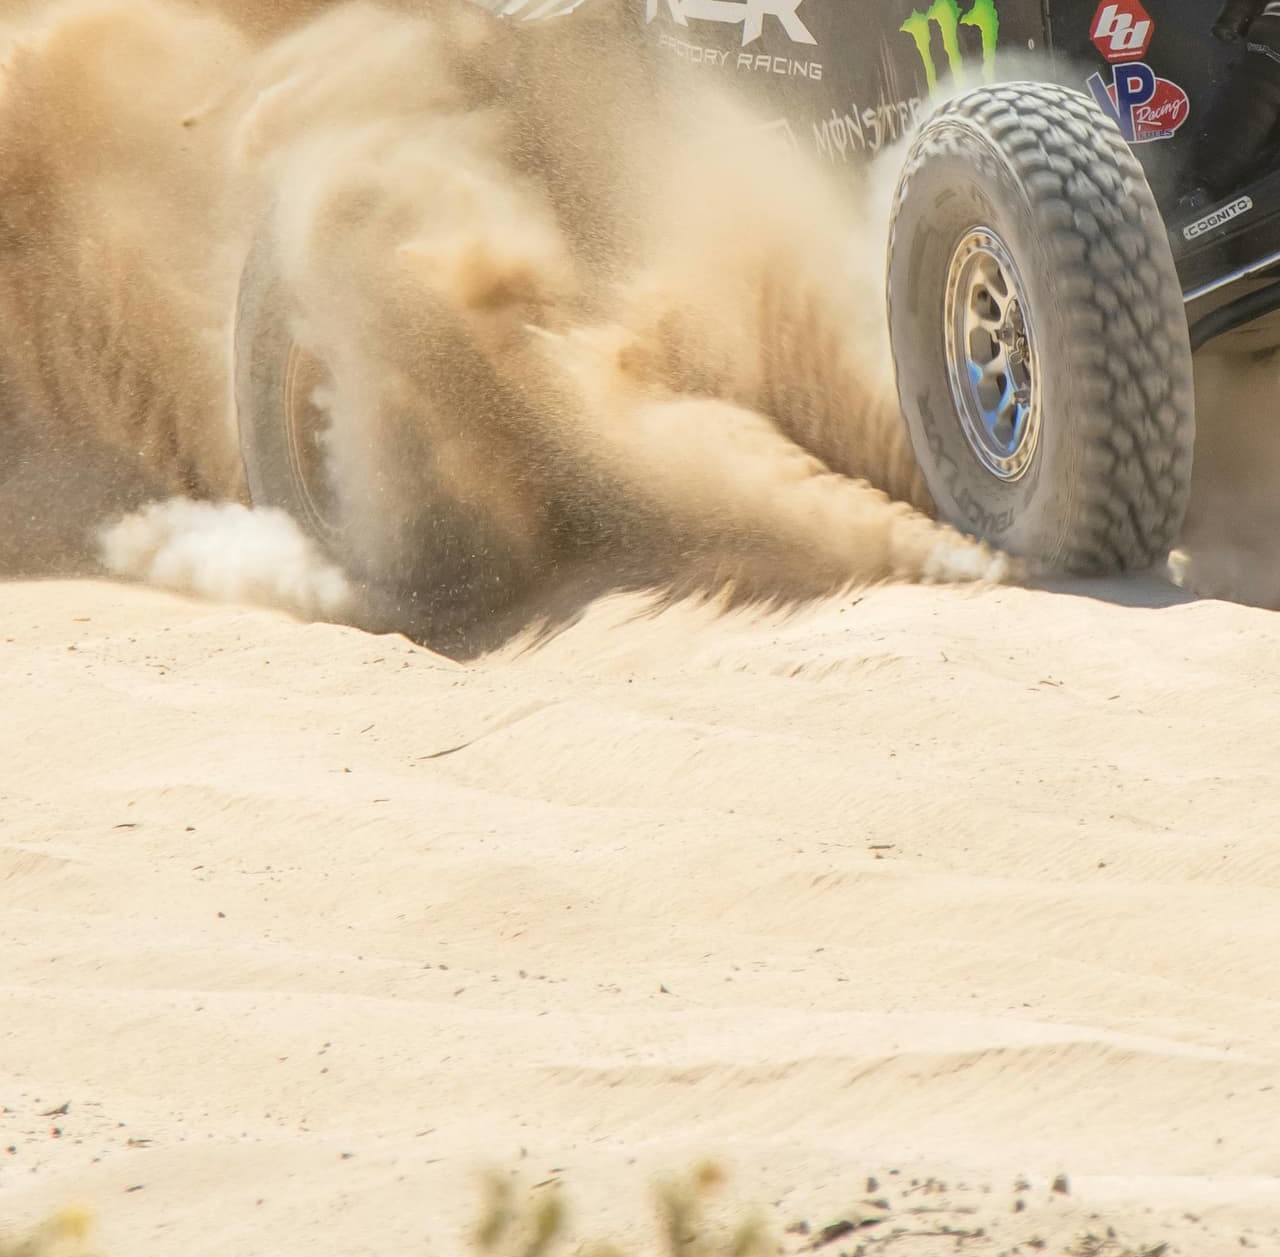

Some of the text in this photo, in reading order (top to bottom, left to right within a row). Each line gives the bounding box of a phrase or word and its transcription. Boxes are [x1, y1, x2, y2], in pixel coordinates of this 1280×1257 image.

[1094, 4, 1151, 50] bd
[736, 52, 823, 80] RACING
[1086, 62, 1155, 144] VP
[1136, 99, 1185, 125] Racing
[1188, 199, 1248, 236] COGNITO
